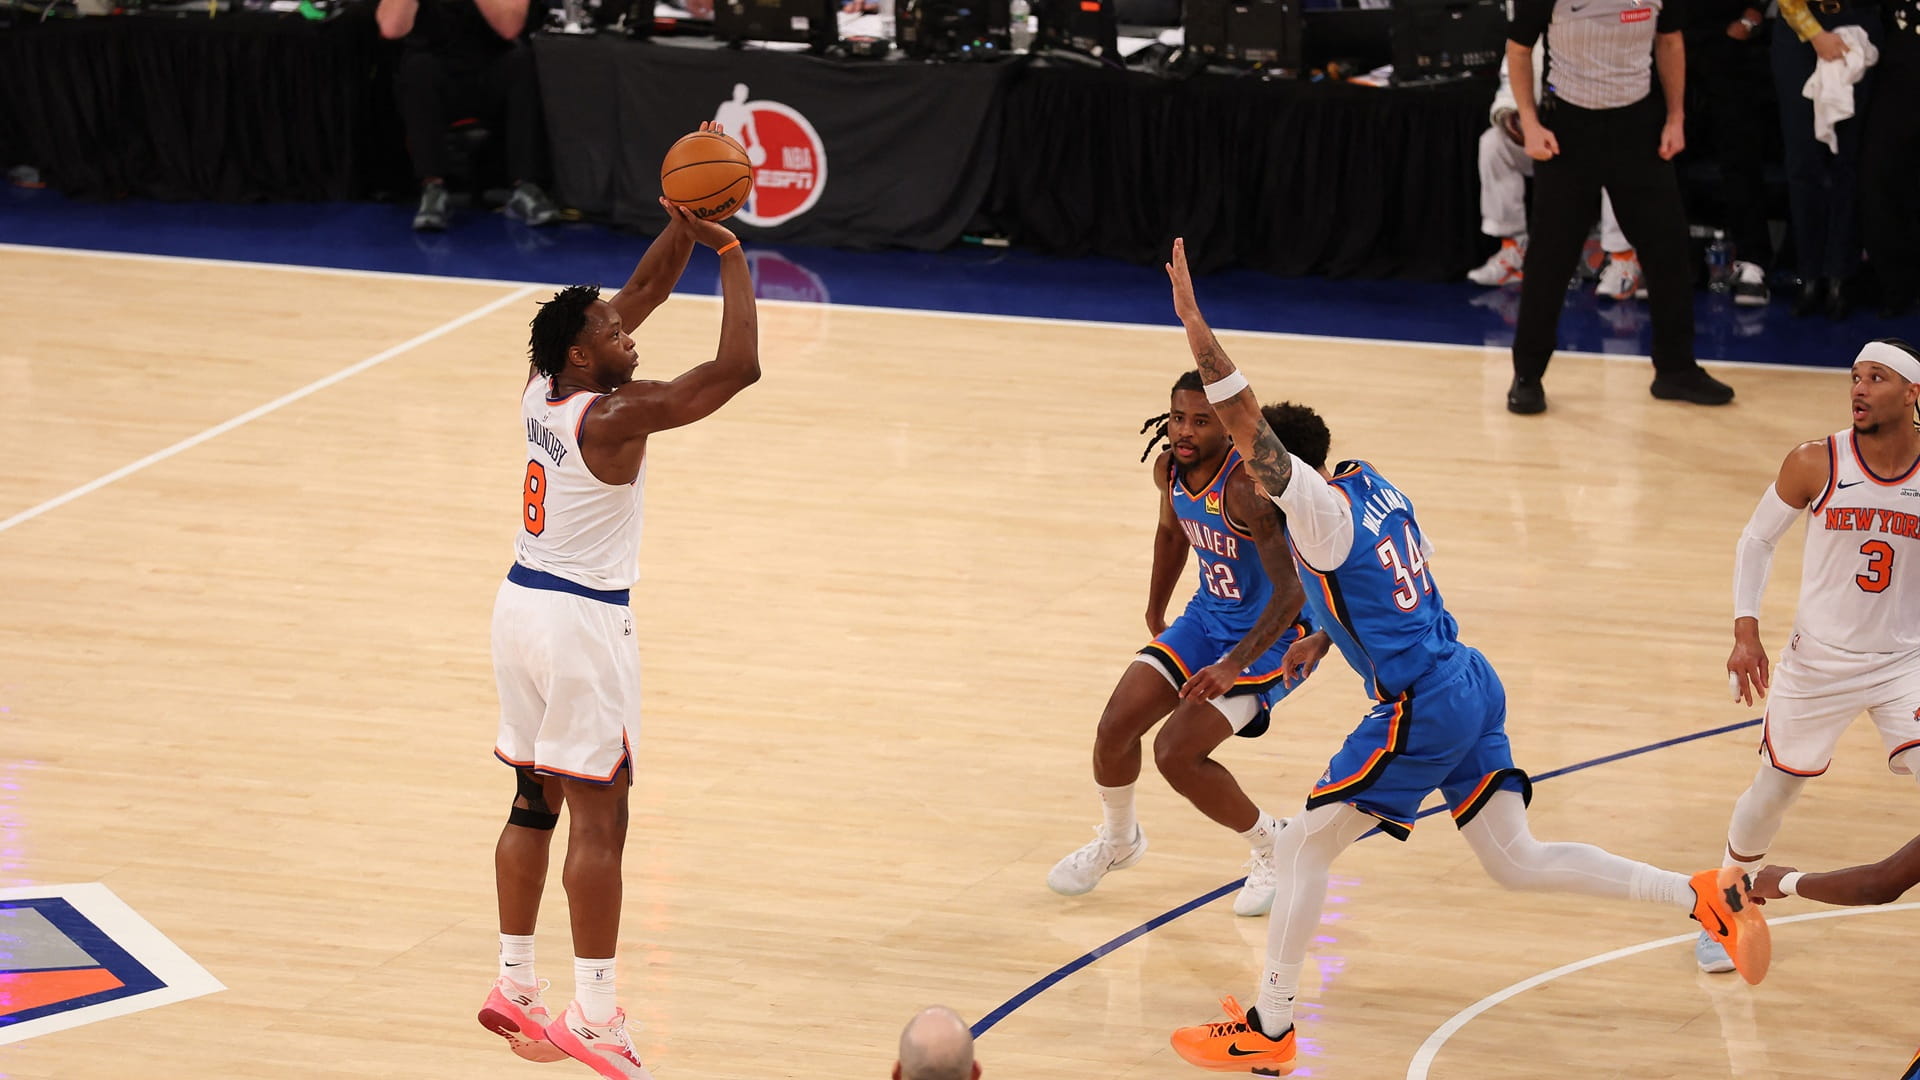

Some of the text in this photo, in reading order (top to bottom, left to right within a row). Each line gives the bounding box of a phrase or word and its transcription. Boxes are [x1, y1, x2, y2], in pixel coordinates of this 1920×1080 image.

[757, 170, 813, 188] ESPN
[783, 147, 812, 169] NBA
[692, 197, 737, 219] lson
[527, 417, 567, 467] ANUNOBY
[523, 459, 546, 537] 8
[1362, 489, 1408, 537] WILLIAM
[1825, 507, 1920, 540] NEW YOR
[1200, 557, 1242, 600] 22
[1375, 520, 1432, 612] 34
[1856, 539, 1895, 593] 3
